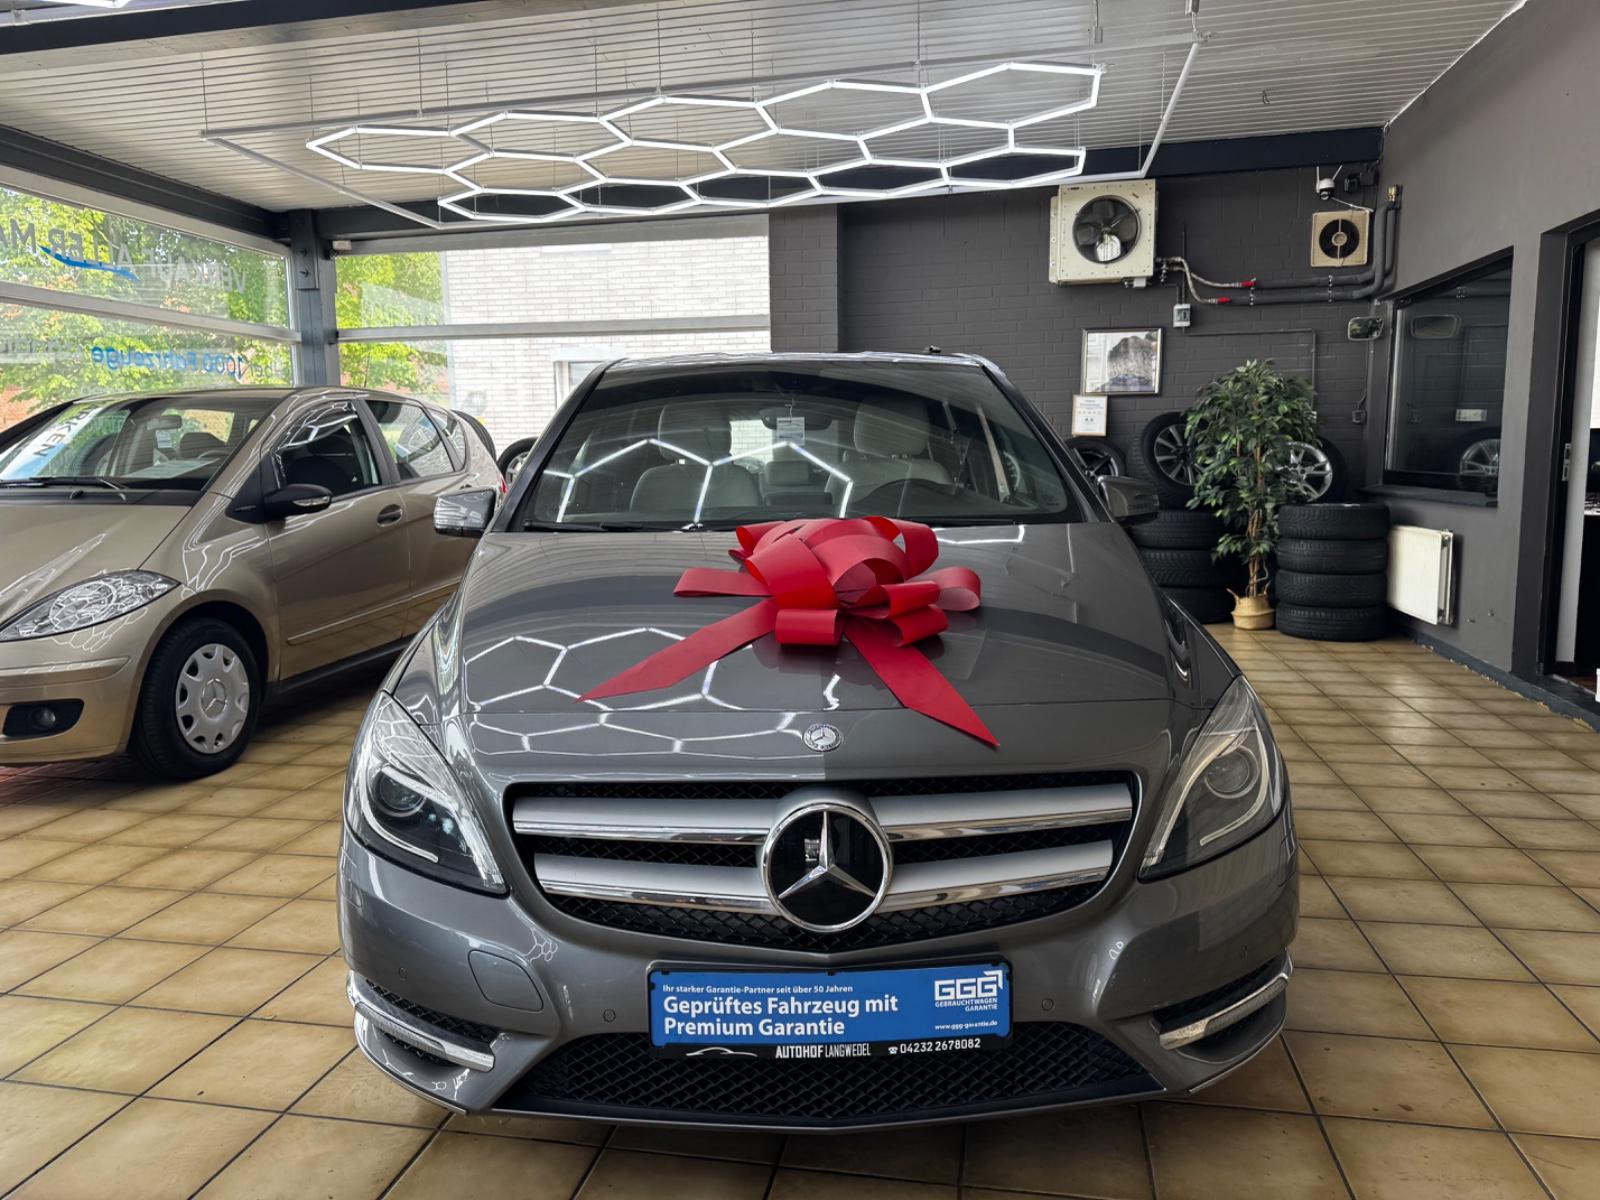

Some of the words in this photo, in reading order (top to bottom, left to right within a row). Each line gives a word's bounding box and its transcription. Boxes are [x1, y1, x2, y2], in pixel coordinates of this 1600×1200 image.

[662, 984, 674, 993] Ihr
[676, 984, 705, 993] starker
[706, 985, 776, 994] Garantie-Partner
[776, 985, 792, 994] seit
[792, 985, 813, 994] über
[813, 985, 825, 994] 50
[825, 984, 854, 993] Jahren
[934, 975, 998, 1001] GGG
[663, 995, 763, 1018] Geprüftes
[767, 996, 860, 1018] Fahrzeug
[865, 994, 899, 1013] mit
[934, 998, 998, 1008] GEBRAUCHTWAGEN
[964, 1003, 998, 1013] GARANTIE
[664, 1017, 754, 1036] Premium
[758, 1017, 845, 1036] Garantie
[775, 1044, 824, 1059] AUTOHOF
[824, 1043, 871, 1058] LANGWEDEL
[900, 1041, 933, 1054] 04232
[935, 1038, 981, 1051] 2678082
